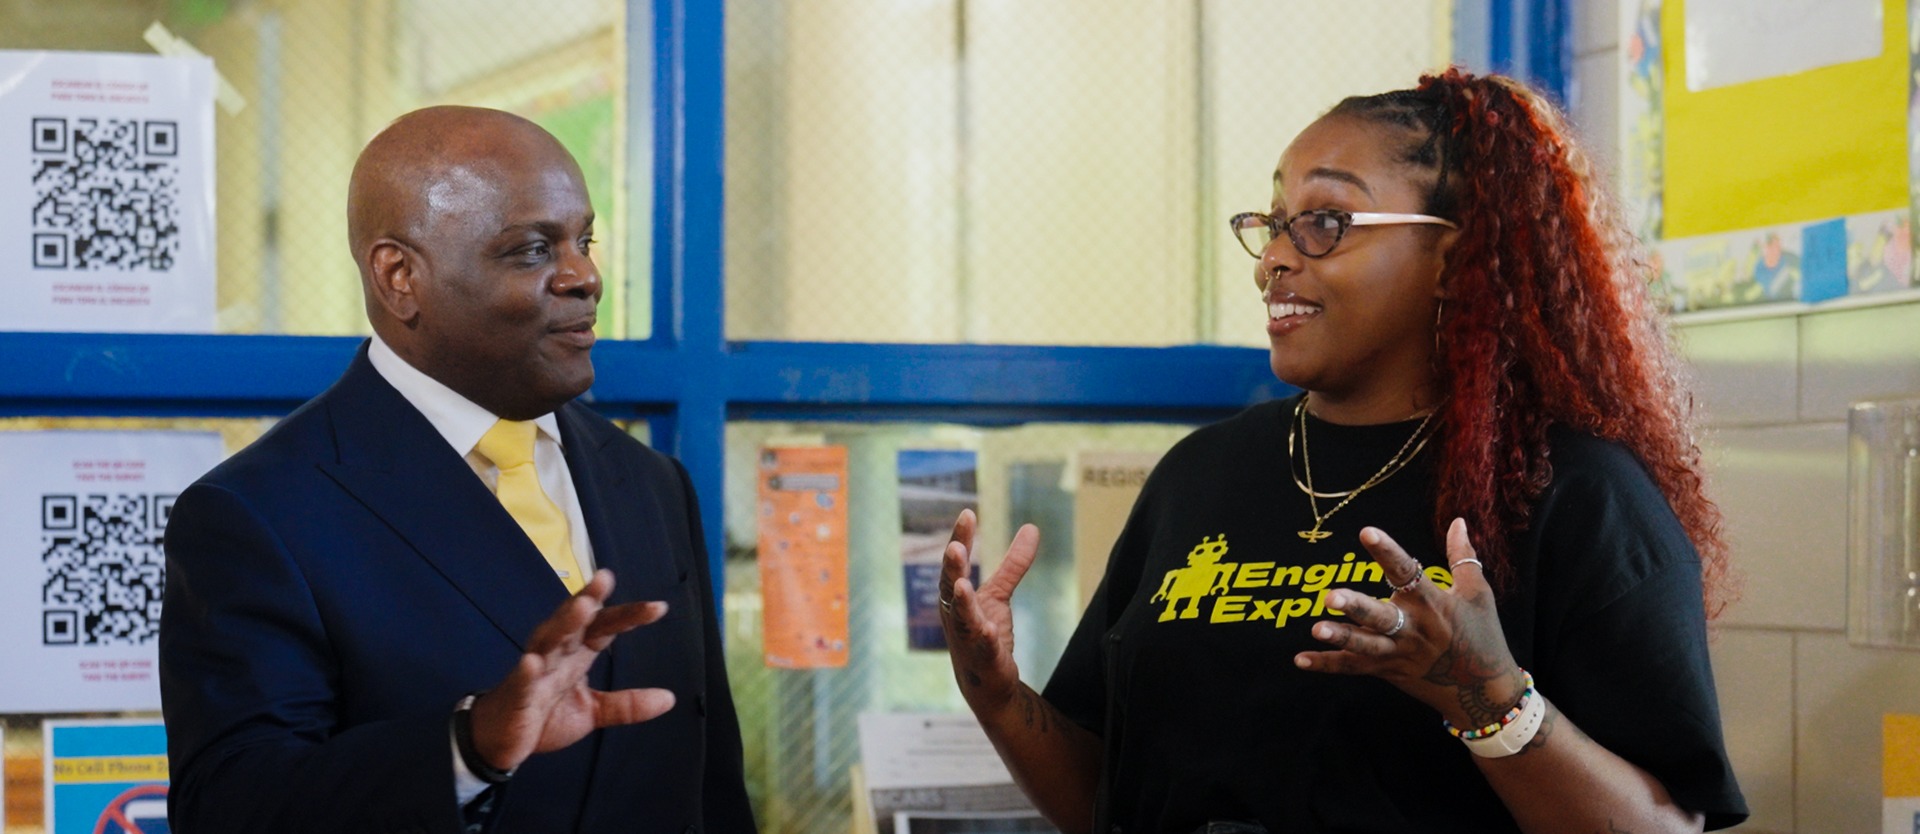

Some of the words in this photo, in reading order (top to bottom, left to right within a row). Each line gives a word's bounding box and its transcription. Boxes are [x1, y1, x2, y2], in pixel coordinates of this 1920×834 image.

[1082, 467, 1149, 487] REGIS
[1231, 553, 1455, 594] Engine
[77, 761, 104, 775] Cell
[109, 760, 152, 775] Phone
